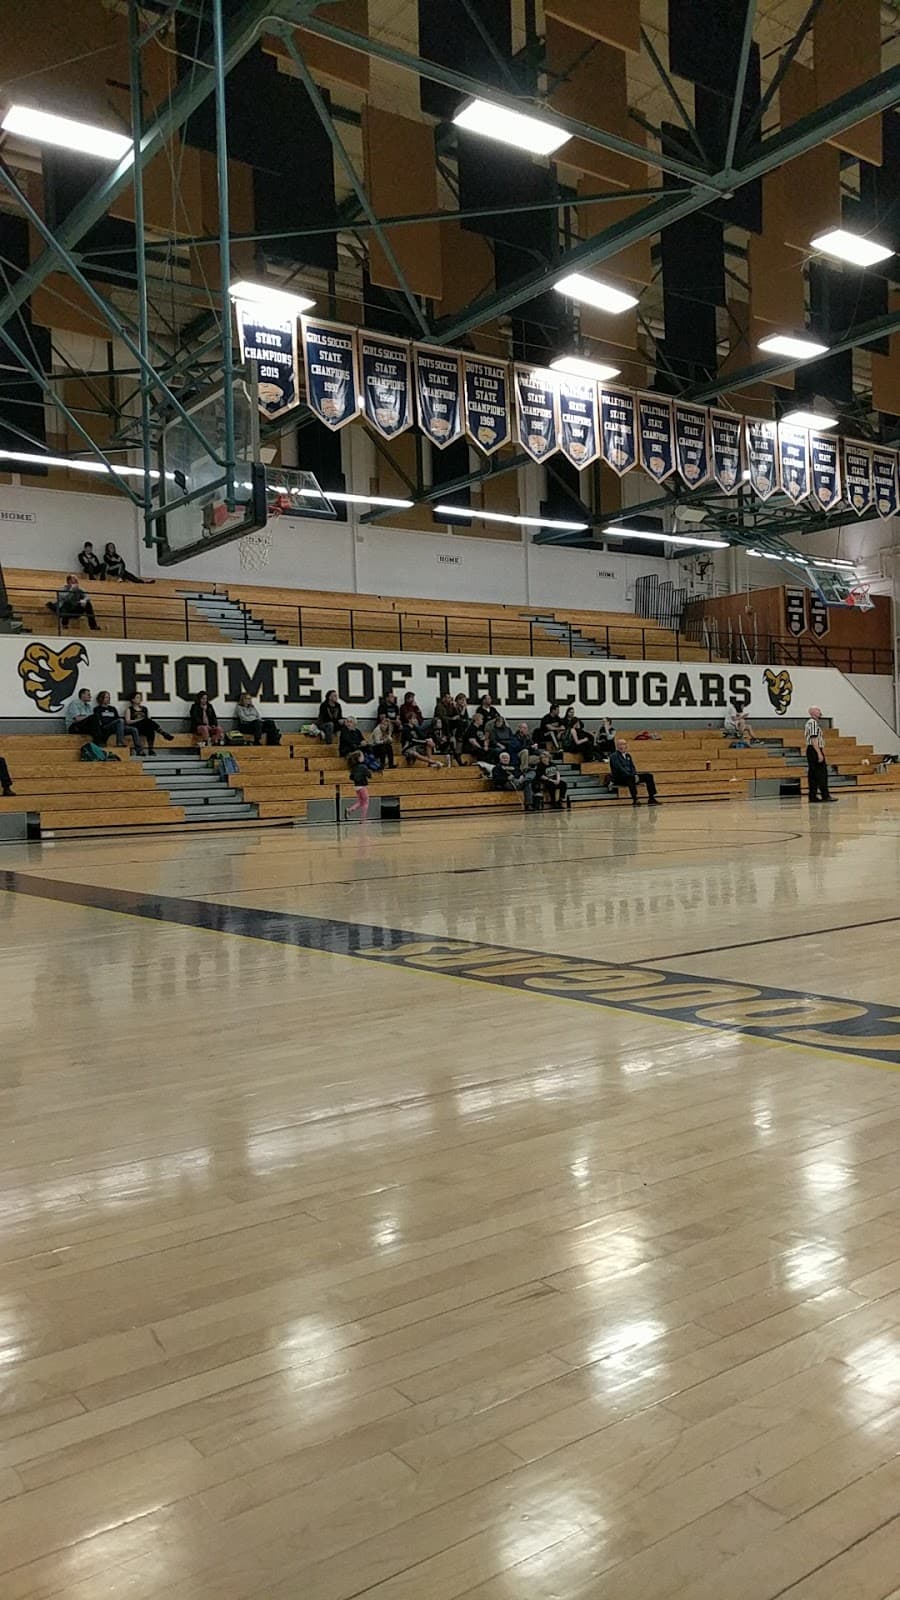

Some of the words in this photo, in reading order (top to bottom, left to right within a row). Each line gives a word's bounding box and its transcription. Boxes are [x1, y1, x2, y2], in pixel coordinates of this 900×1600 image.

[255, 331, 282, 347] STATE
[306, 332, 327, 346] GIRLS
[327, 337, 353, 351] SOCCER
[244, 347, 293, 367] CHAMPIONS
[319, 350, 343, 363] STATE
[363, 345, 383, 359] GIRLS
[383, 349, 407, 362] SOCCER
[375, 362, 398, 375] STATE
[418, 357, 435, 369] BOYS
[435, 360, 458, 372] SOCCER
[466, 362, 483, 375] BOYS
[484, 366, 505, 379] TRACK
[260, 365, 280, 379] 2015
[311, 364, 350, 380] CHAMPIONS
[366, 375, 405, 391] CHAMPIONS
[428, 373, 449, 386] STATE
[480, 378, 498, 390] FIELD
[421, 386, 456, 401] CHAMPIONS
[475, 389, 497, 403] STATE
[527, 392, 546, 405] STATE
[468, 401, 505, 417] CHAMPIONS
[521, 405, 552, 419] CHAMPIONS
[609, 409, 626, 421] STATE
[640, 404, 670, 418] VOLLEYBALL
[648, 418, 663, 429] STATE
[677, 412, 705, 426] VOLLEYBALL
[603, 421, 632, 435] CHAMPIONS
[683, 425, 699, 437] STATE
[642, 430, 669, 443] CHAMPIONS
[678, 437, 704, 450] CHAMPIONS
[1, 512, 33, 522] HOME
[115, 653, 322, 704] HOME
[337, 661, 413, 705] OF
[426, 664, 536, 707] THE
[546, 668, 753, 708] COUGARS
